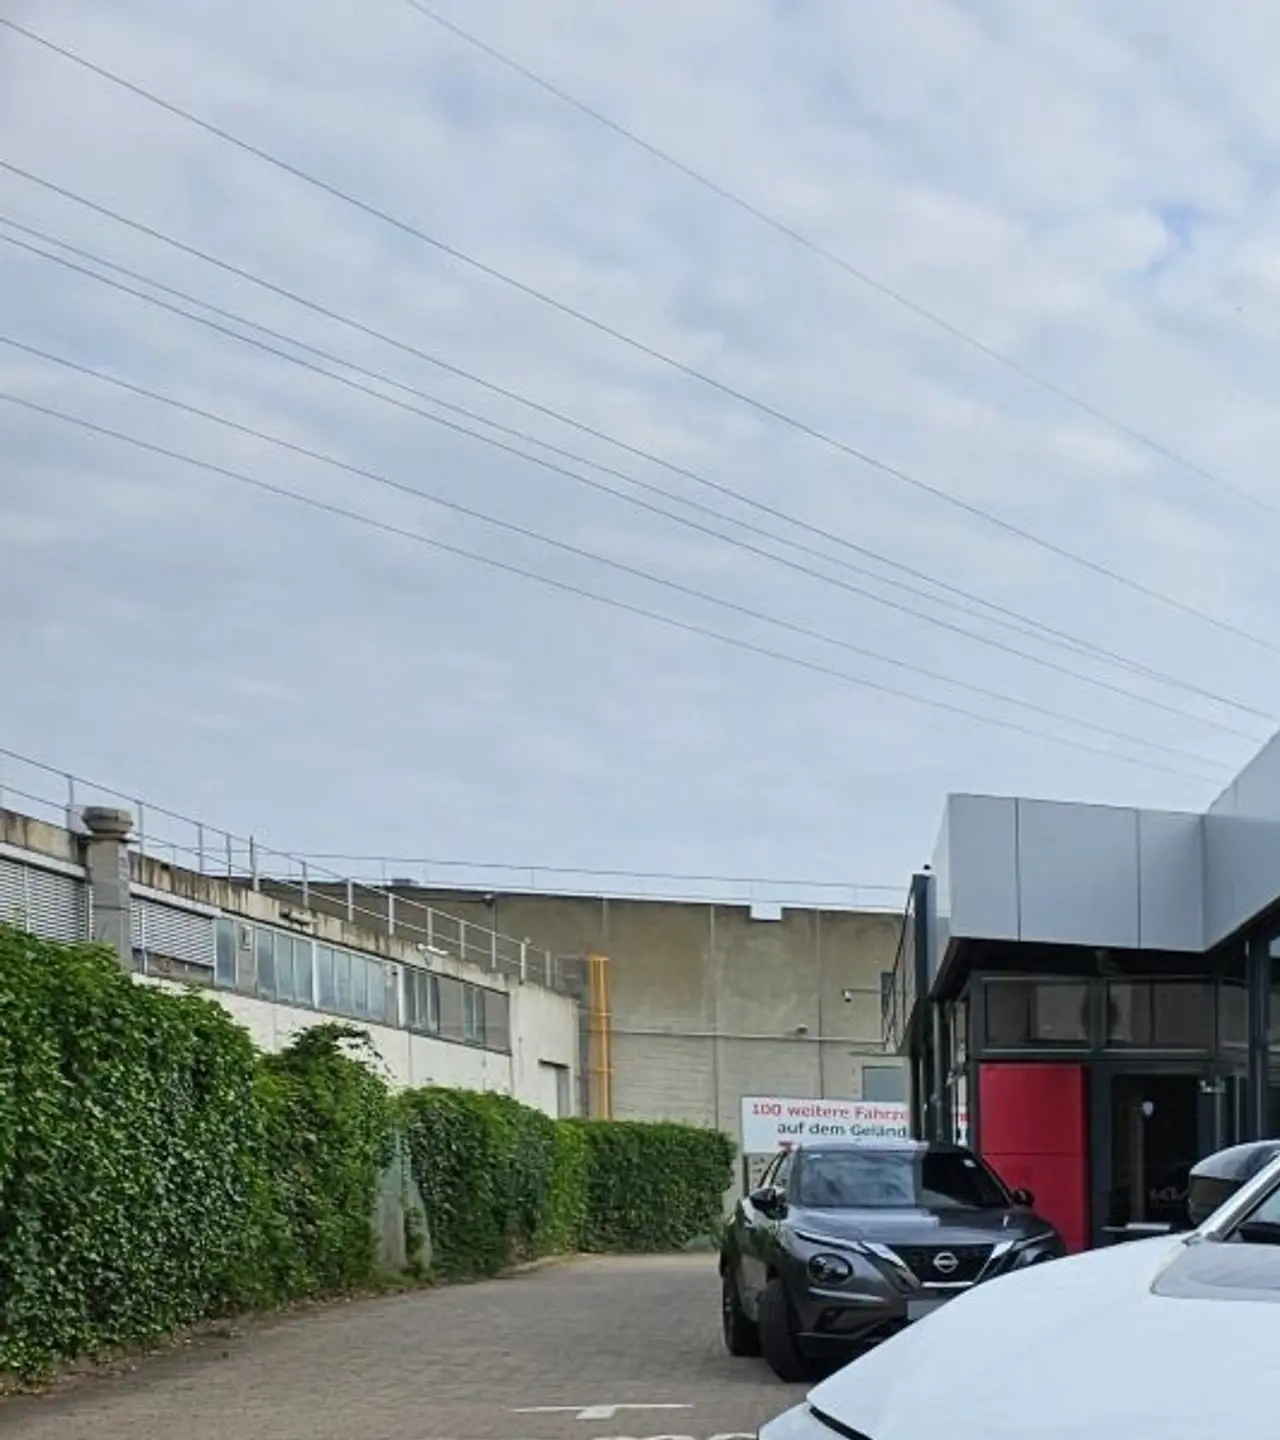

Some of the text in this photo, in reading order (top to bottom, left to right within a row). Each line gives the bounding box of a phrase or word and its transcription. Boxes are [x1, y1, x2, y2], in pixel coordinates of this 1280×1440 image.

[752, 1103, 781, 1115] 100
[787, 1105, 849, 1119] weitere
[777, 1122, 803, 1135] auf
[808, 1123, 846, 1137] dem
